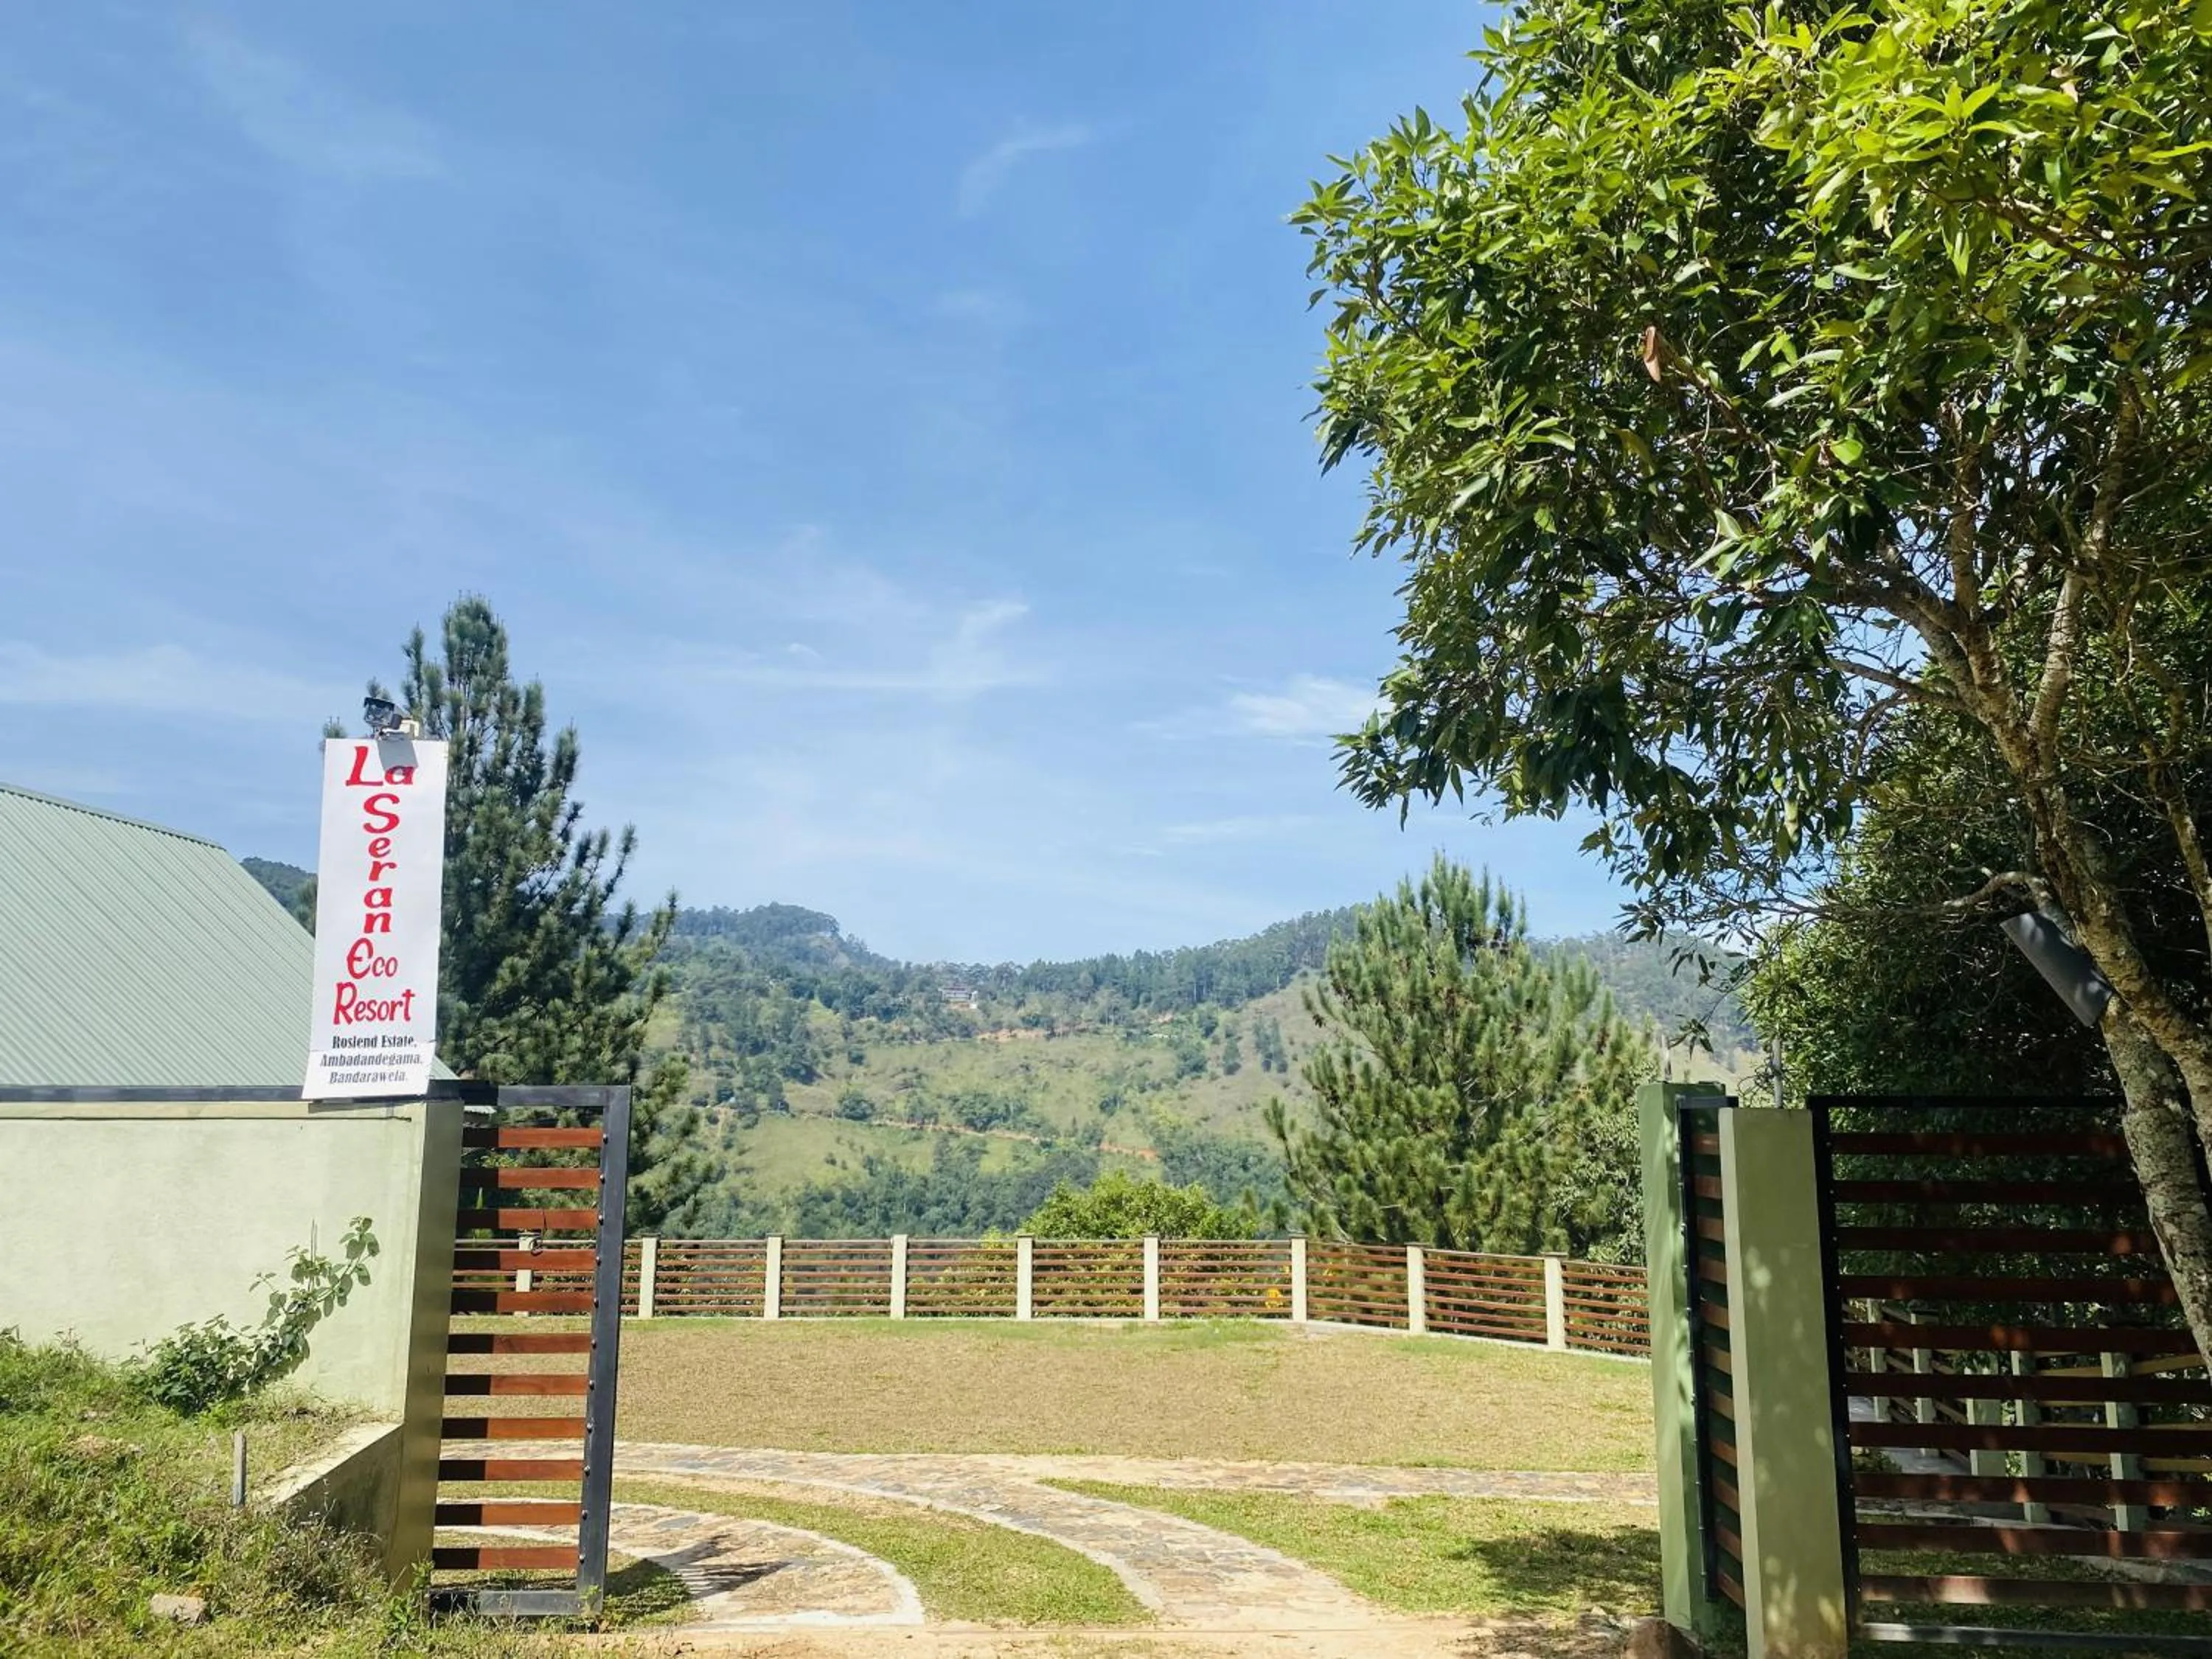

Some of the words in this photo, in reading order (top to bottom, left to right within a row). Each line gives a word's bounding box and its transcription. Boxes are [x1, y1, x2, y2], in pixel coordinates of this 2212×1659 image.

[345, 745, 414, 787] La
[347, 937, 399, 980] Eco
[333, 981, 415, 1026] Resort
